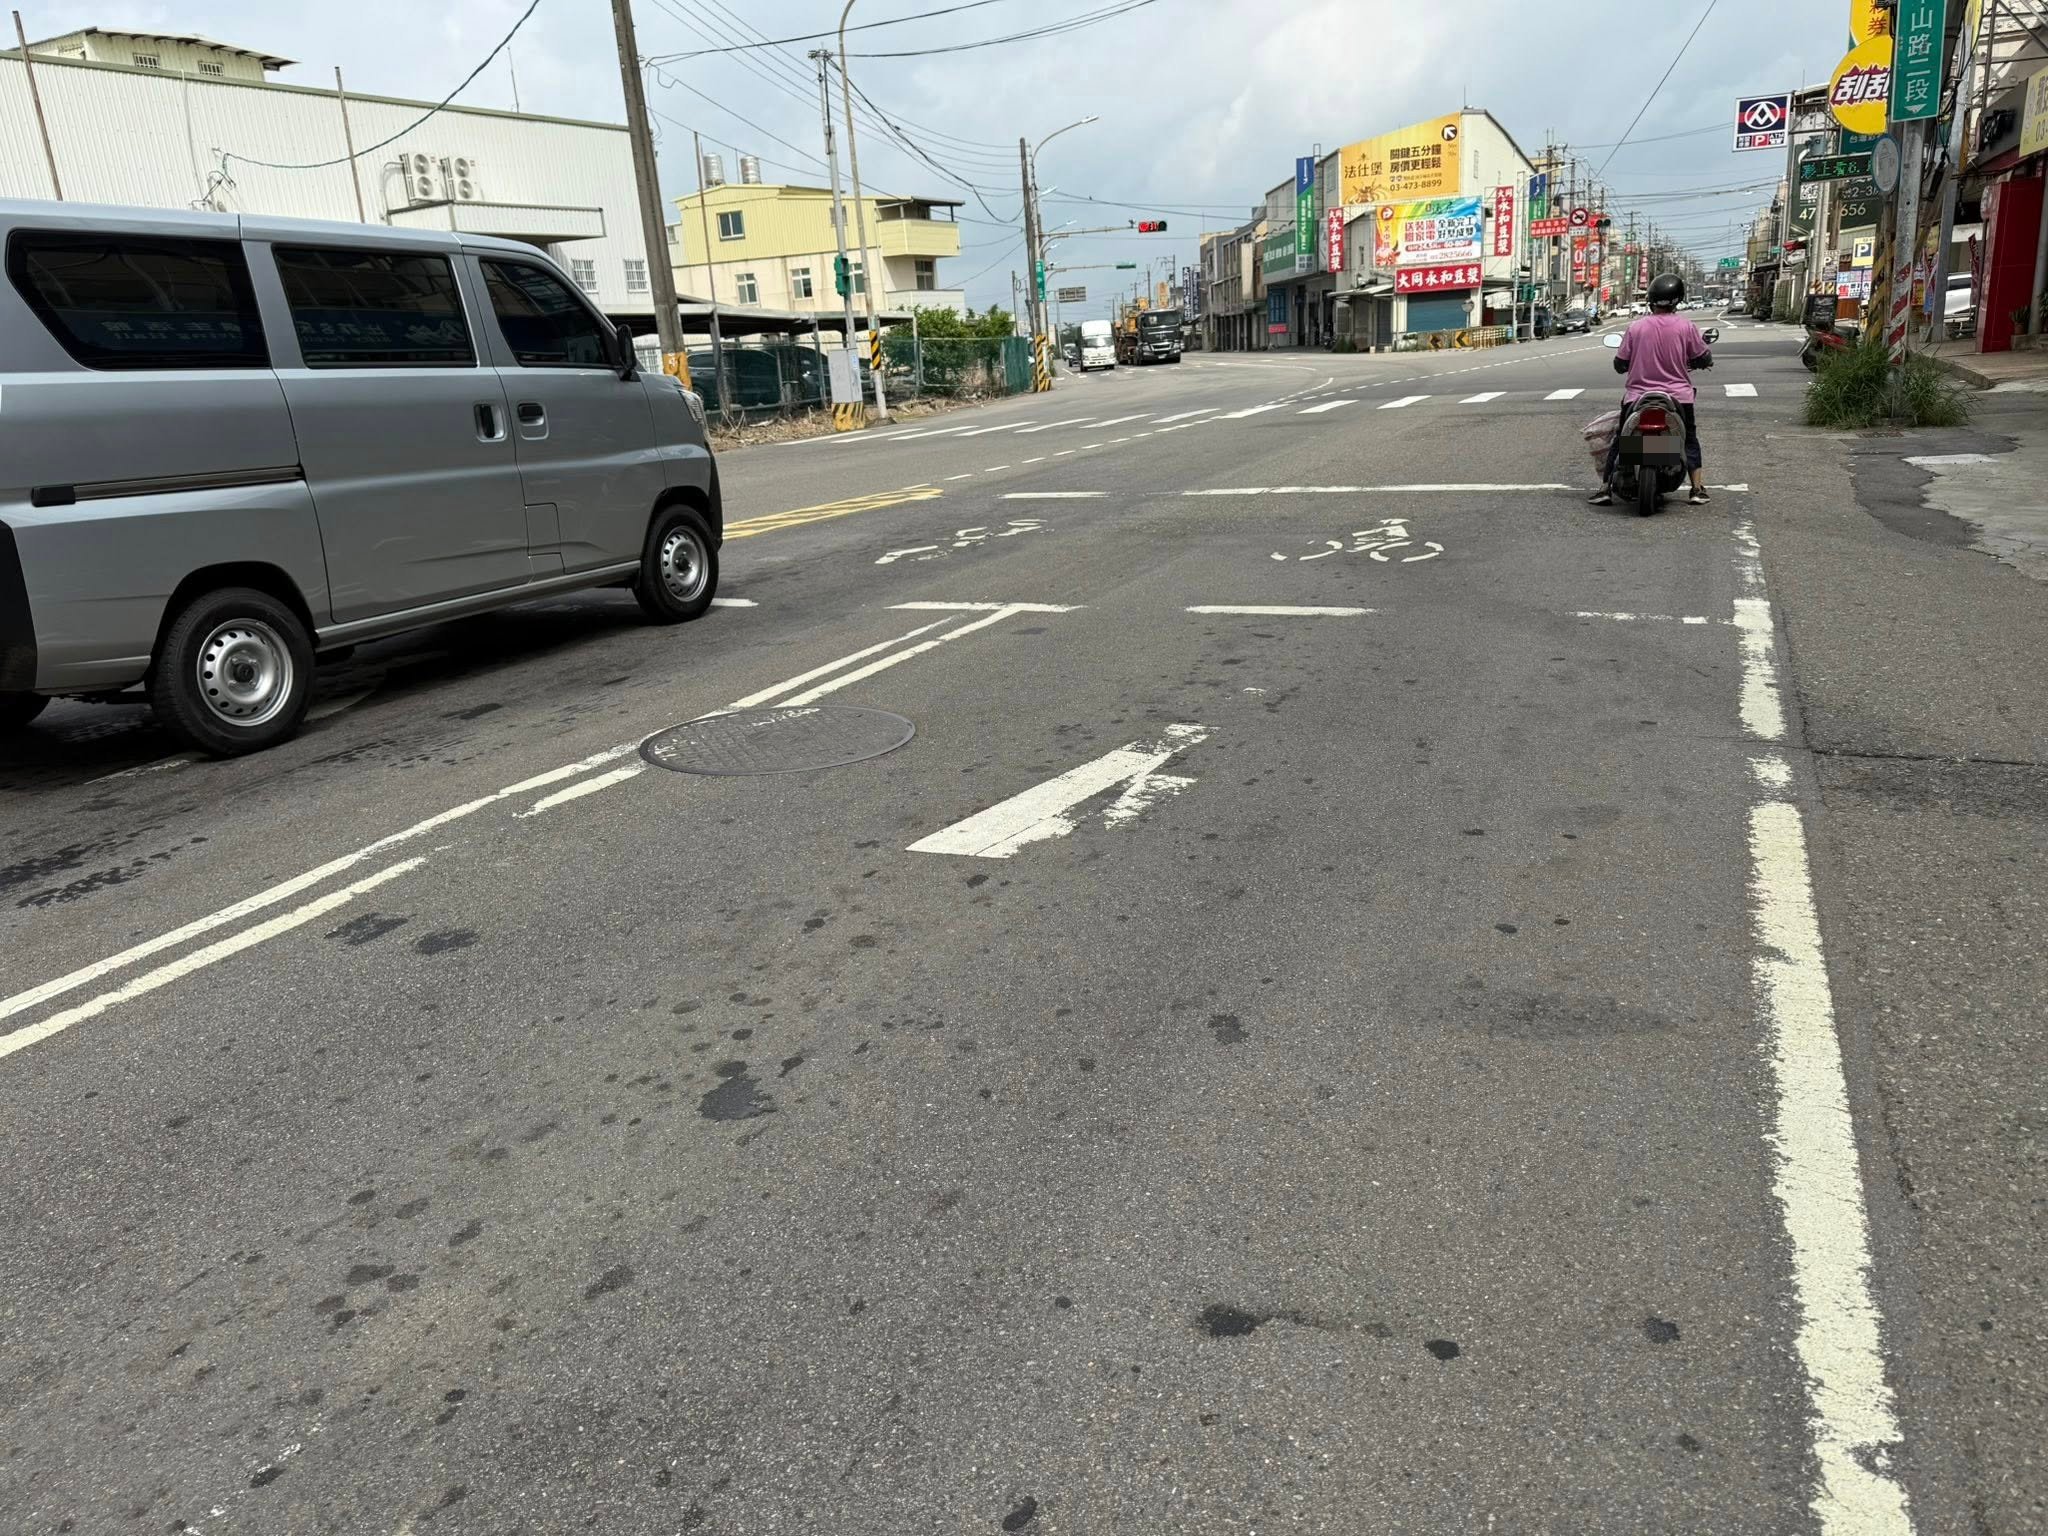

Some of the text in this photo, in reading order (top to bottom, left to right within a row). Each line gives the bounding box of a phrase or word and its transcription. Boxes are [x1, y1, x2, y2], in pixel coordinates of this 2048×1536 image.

[1905, 0, 1933, 102] 山路二段
[1390, 144, 1442, 160] 關鍵五分鐘
[1344, 162, 1382, 179] 法仕堡
[1389, 157, 1442, 174] 房價更輕鬆
[1389, 179, 1442, 192] 03-473-8899
[1497, 198, 1511, 254] 永和豆漿
[1329, 219, 1342, 270] 永和豆漿
[1398, 267, 1480, 288] 大同永和豆漿
